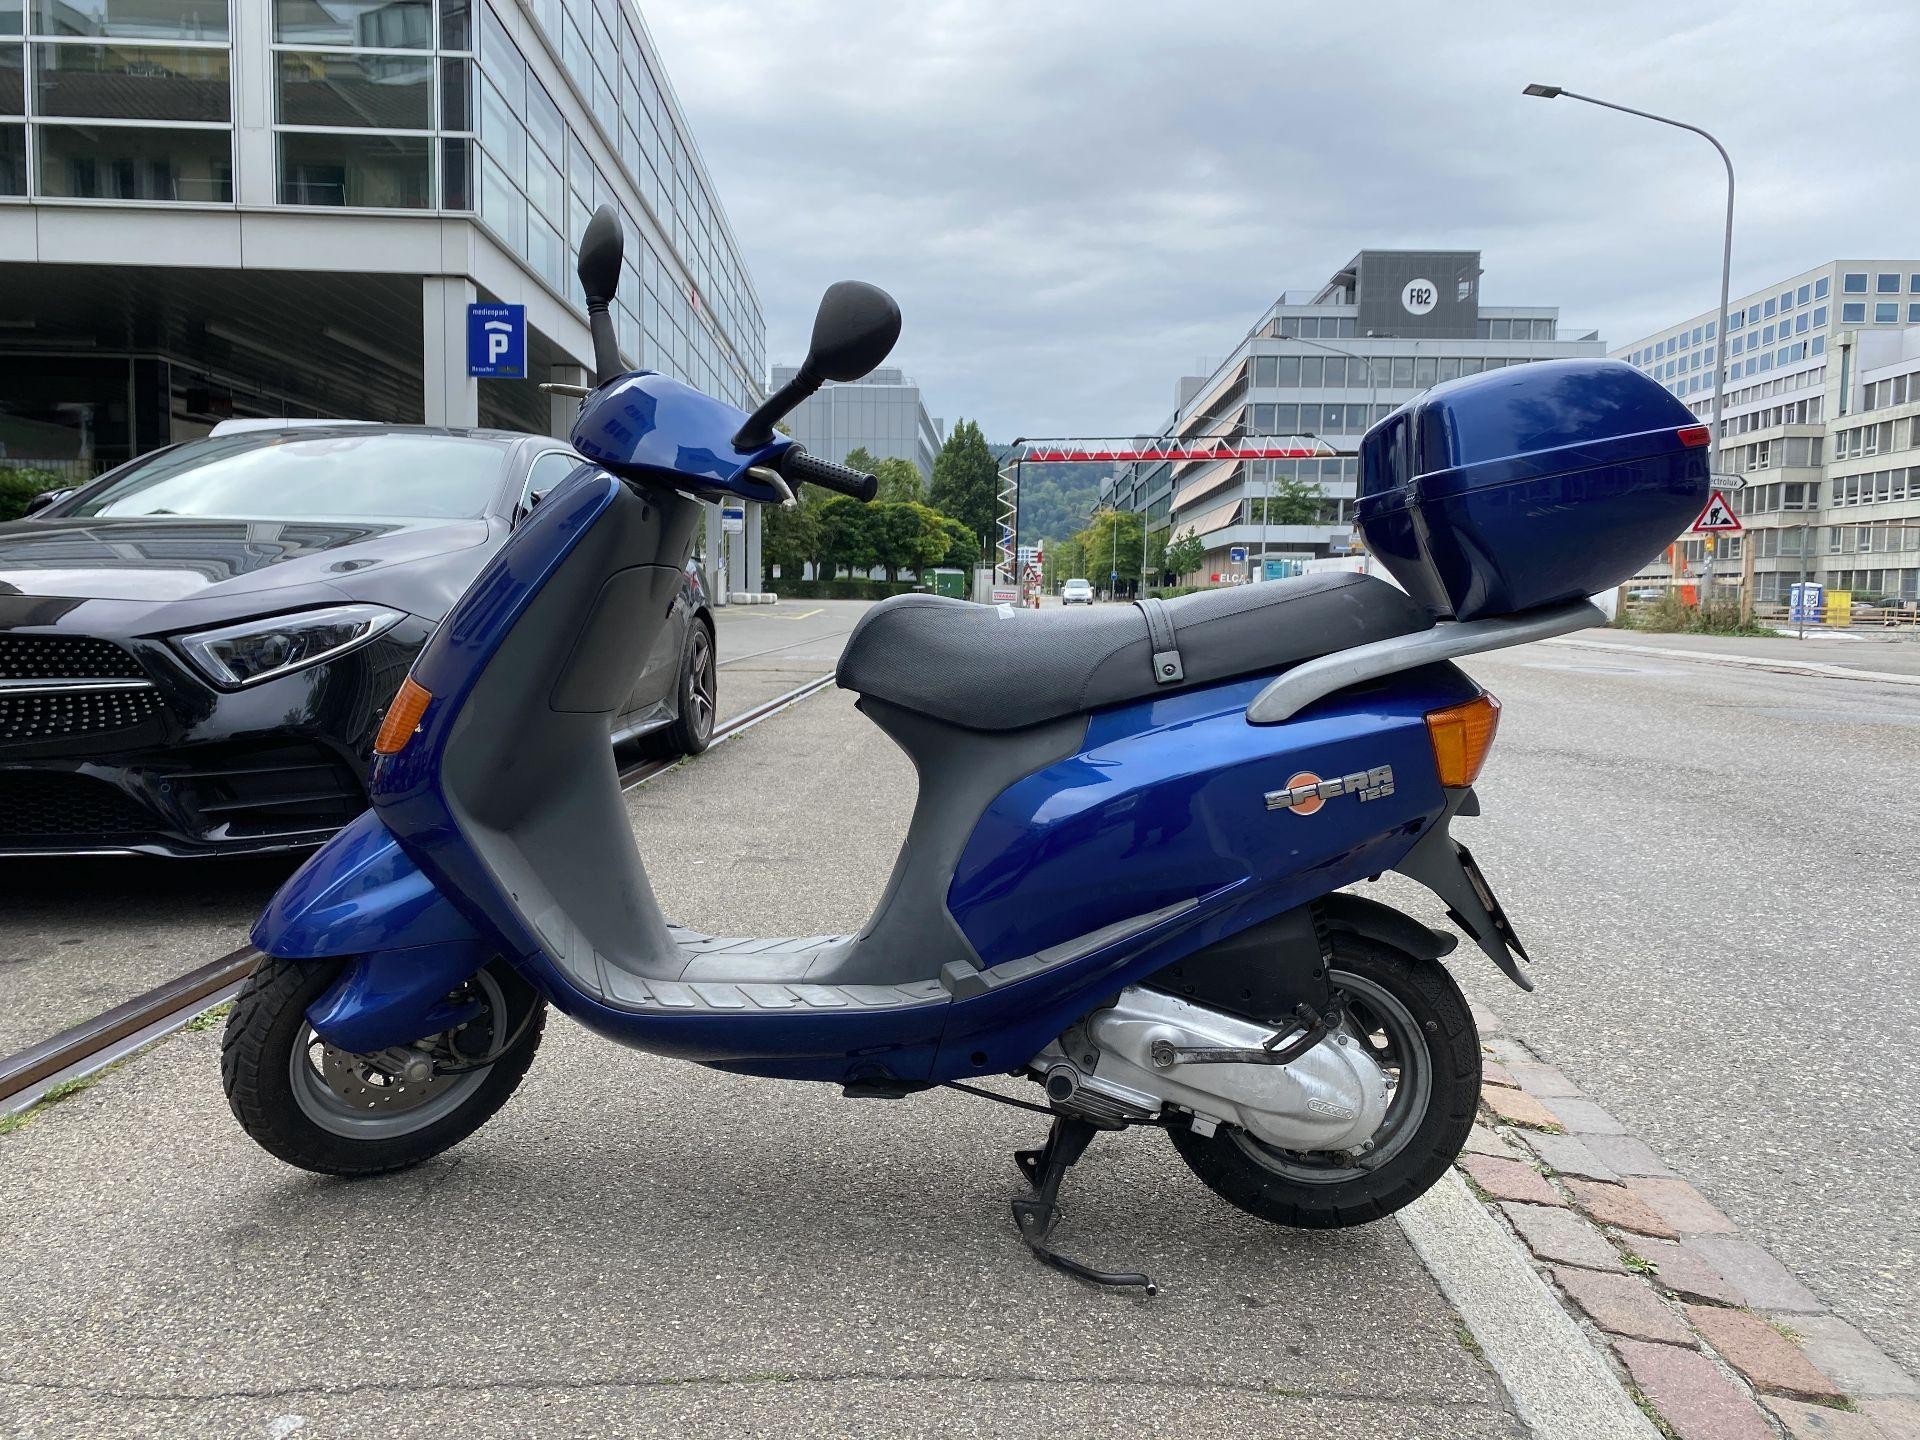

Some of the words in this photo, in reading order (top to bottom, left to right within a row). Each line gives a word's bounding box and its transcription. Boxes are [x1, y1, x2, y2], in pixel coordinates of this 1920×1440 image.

[1409, 288, 1431, 304] F62
[472, 308, 509, 317] medienpark
[488, 333, 509, 364] P
[1710, 477, 1738, 487] ectrolux
[1263, 764, 1394, 811] SFERA
[1359, 782, 1395, 803] 125
